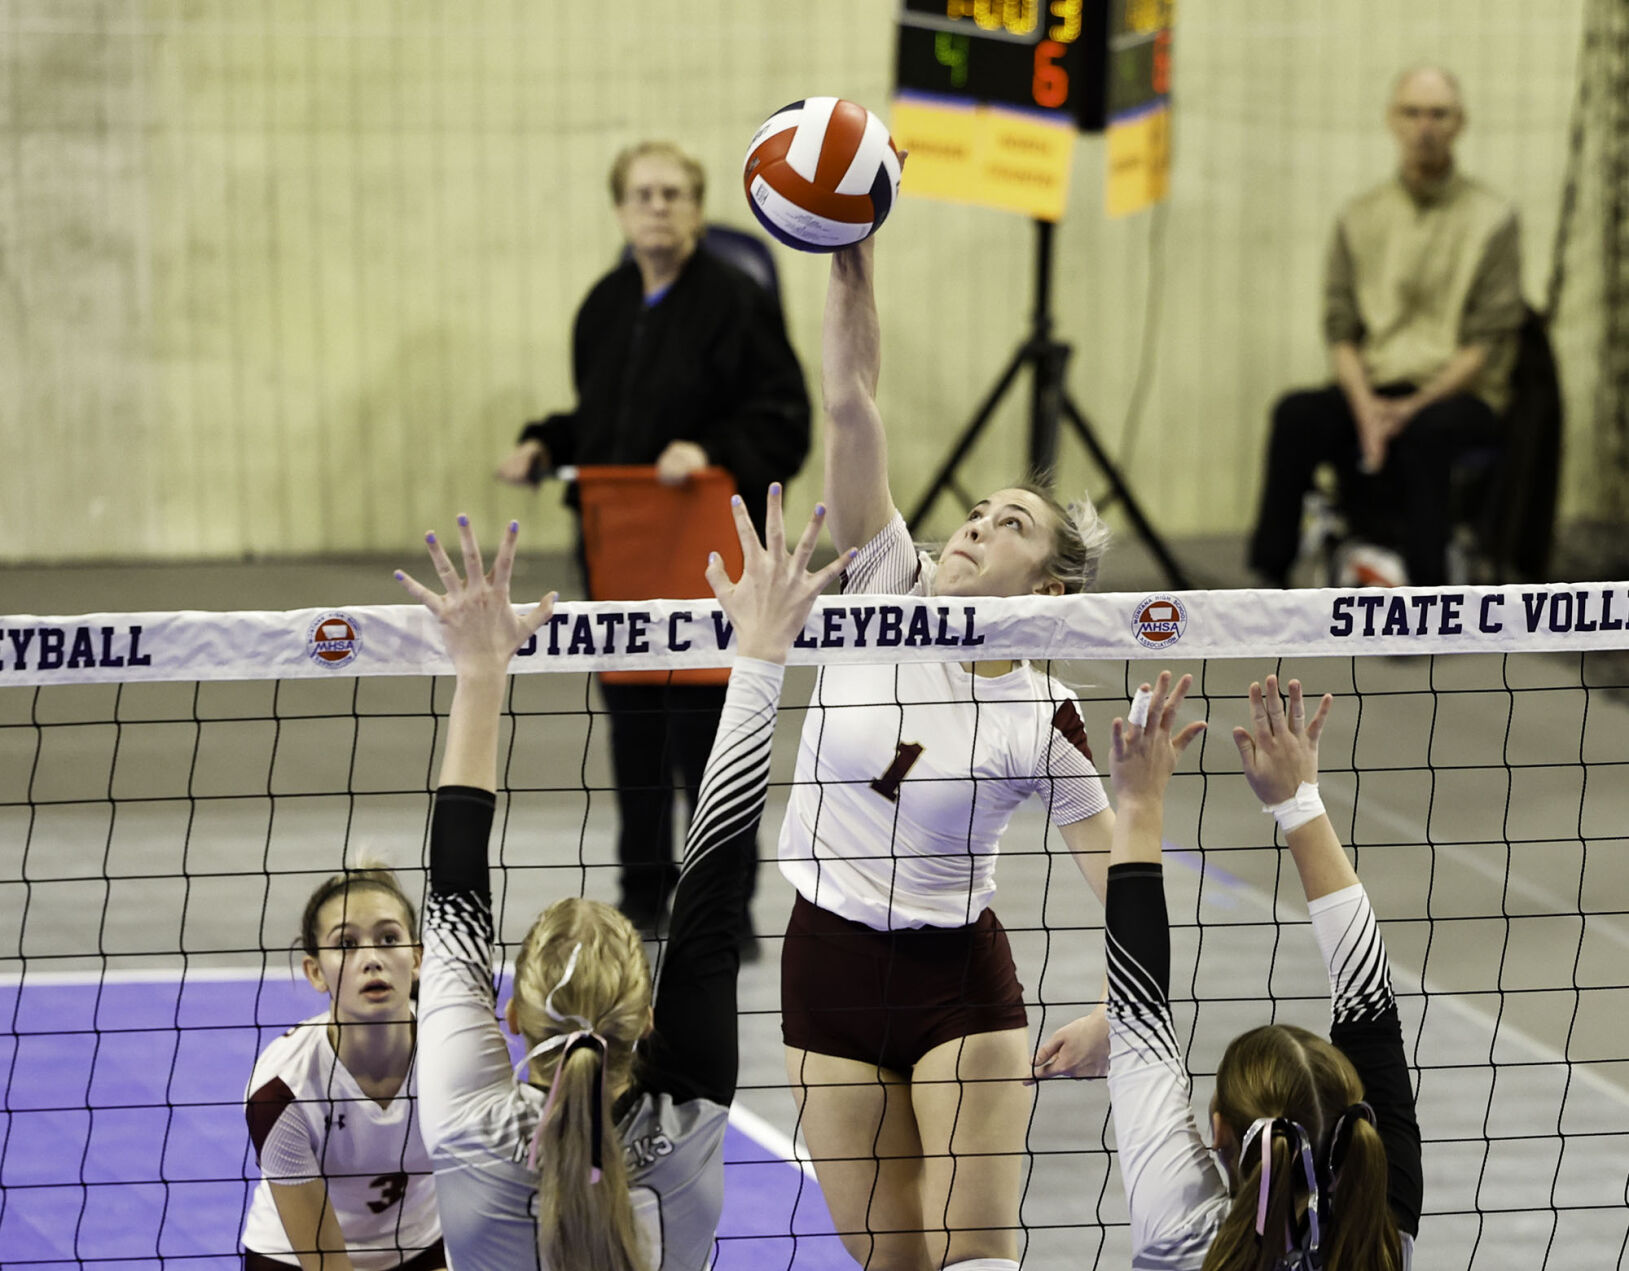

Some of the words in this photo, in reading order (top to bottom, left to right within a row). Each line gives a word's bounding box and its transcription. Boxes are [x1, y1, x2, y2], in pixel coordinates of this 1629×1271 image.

[1032, 39, 1069, 108] 6
[668, 611, 691, 652] C
[1135, 622, 1181, 639] MHSA
[1330, 593, 1464, 637] STATE
[1479, 593, 1505, 634] C
[1522, 589, 1629, 633] VOLL
[0, 626, 151, 671] YBALL
[309, 640, 357, 659] MHSA
[869, 741, 925, 804] 1
[366, 1172, 409, 1214] 3
